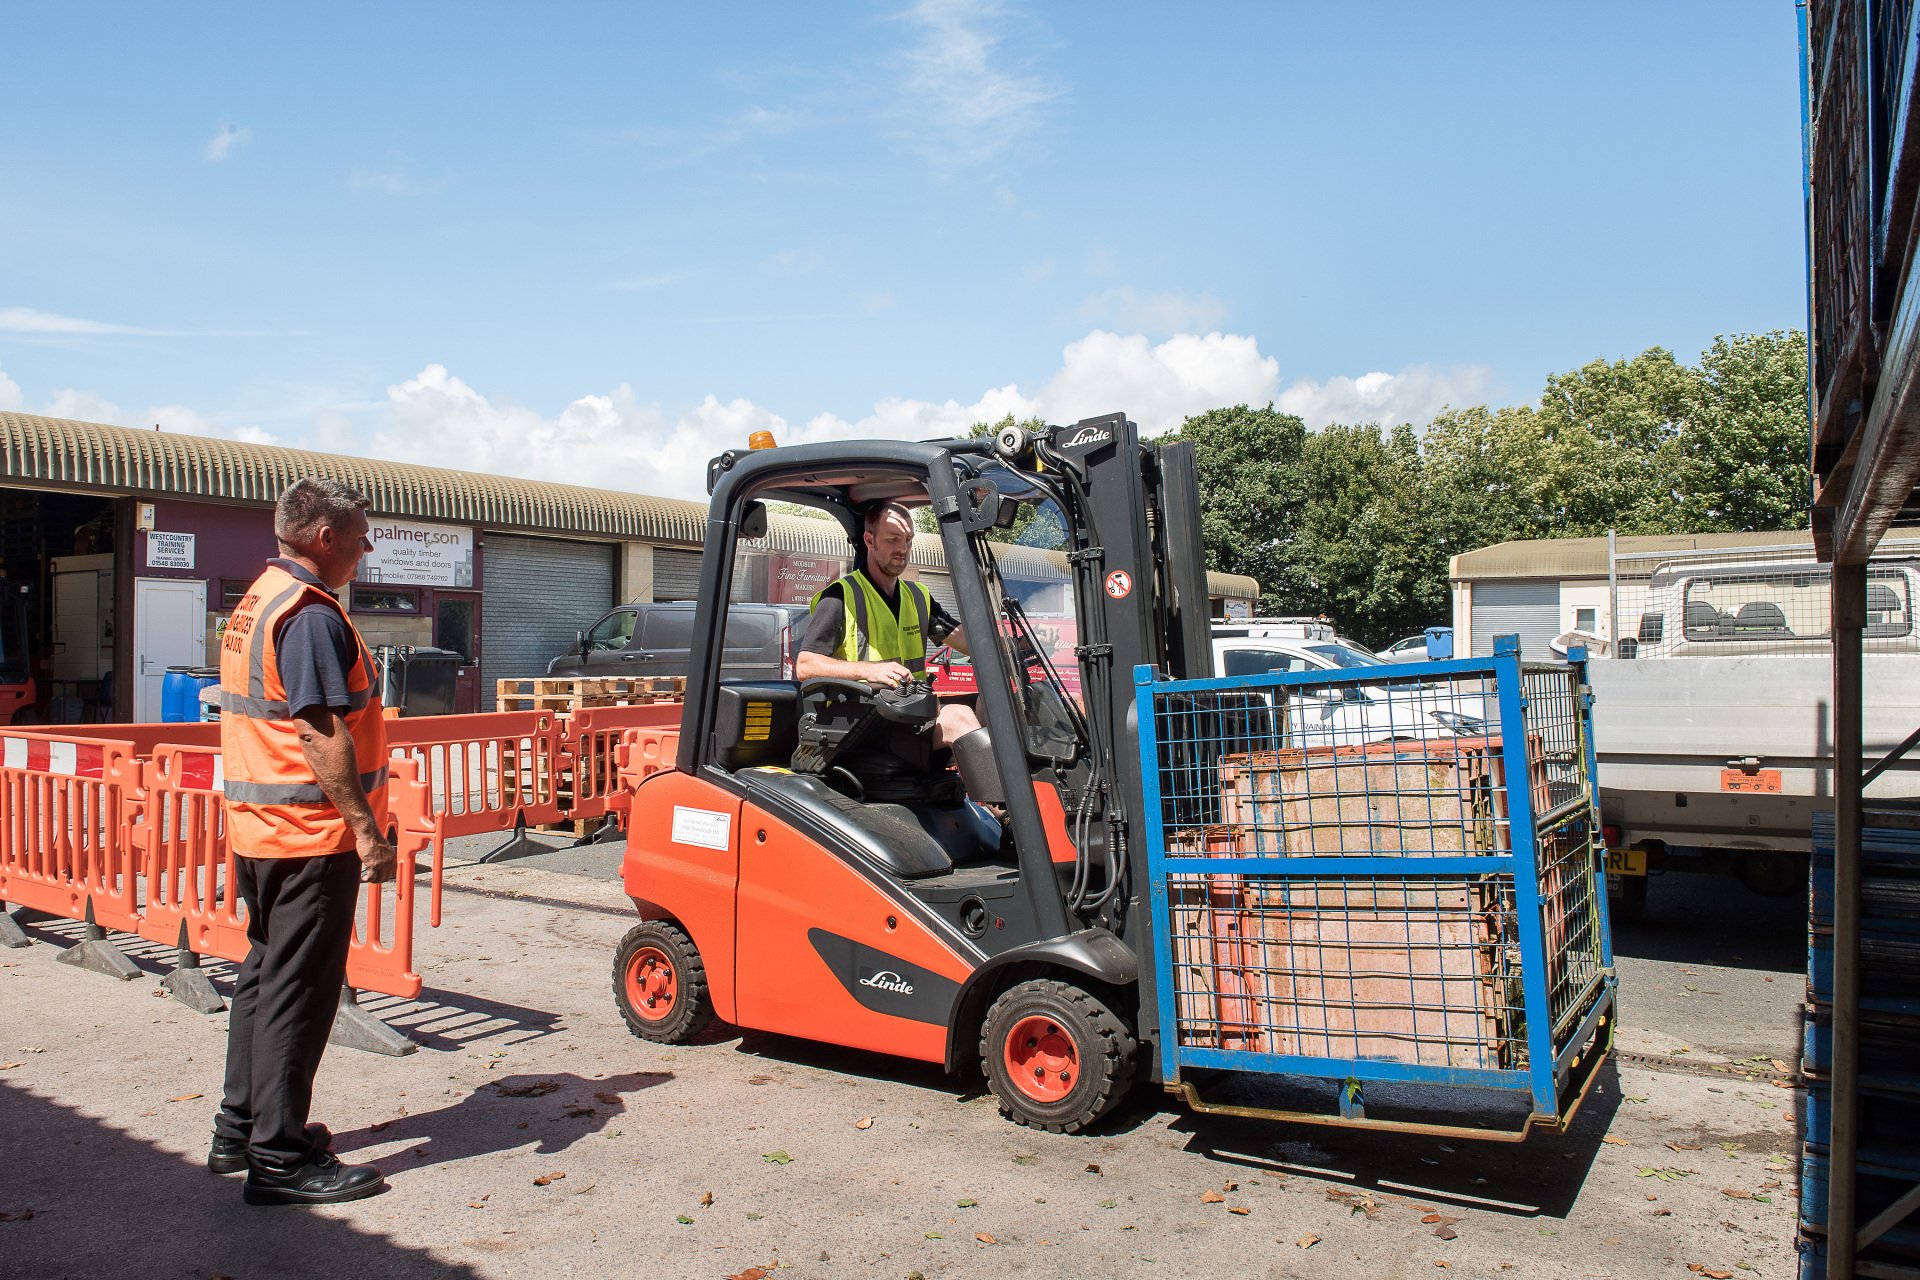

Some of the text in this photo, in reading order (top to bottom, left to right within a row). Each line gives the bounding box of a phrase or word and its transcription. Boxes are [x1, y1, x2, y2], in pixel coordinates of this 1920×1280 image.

[1062, 427, 1110, 448] Linde
[150, 532, 193, 542] WESTCOUNTRY
[373, 525, 429, 543] palmer
[433, 532, 459, 545] son
[157, 541, 185, 549] TRAINING
[157, 547, 185, 555] SERVICES
[392, 548, 441, 558] quality timber
[381, 558, 452, 569] windows and doors
[777, 567, 832, 582] Fine Furniture
[1605, 852, 1636, 871] RL
[859, 970, 914, 995] Linde
